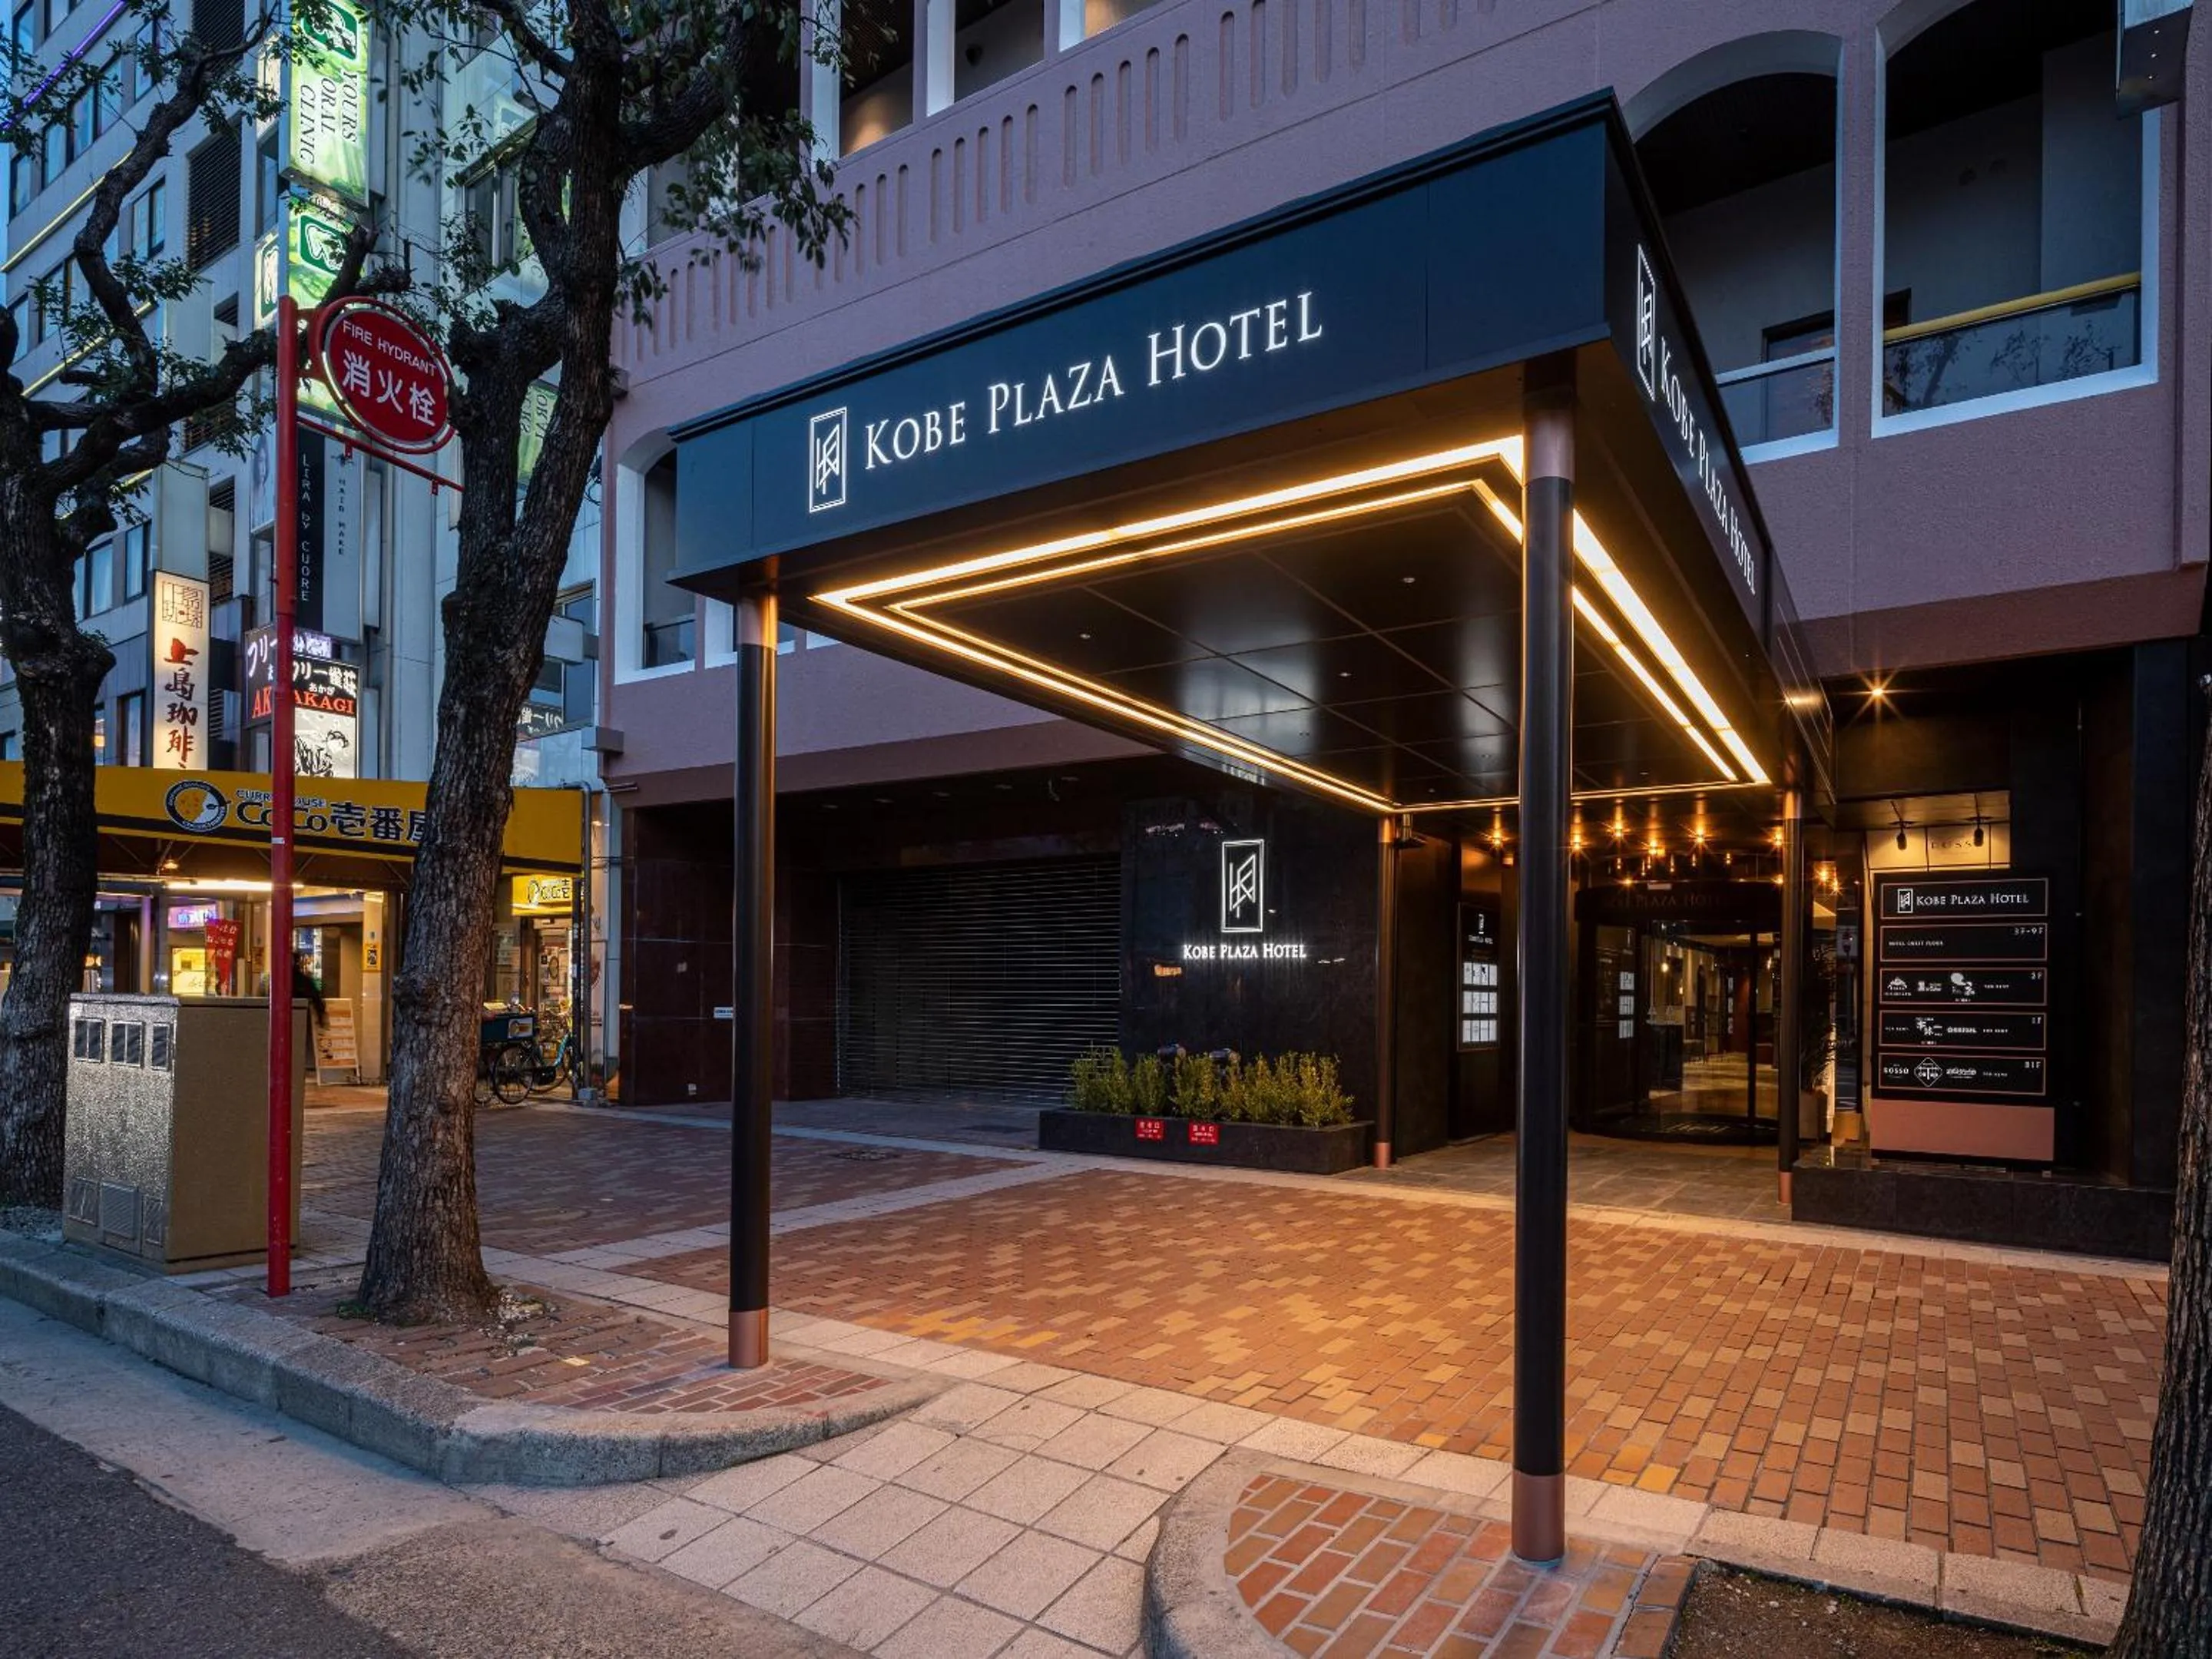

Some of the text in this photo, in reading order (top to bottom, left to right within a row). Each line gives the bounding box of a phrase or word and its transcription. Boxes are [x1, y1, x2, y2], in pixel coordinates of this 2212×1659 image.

[300, 84, 316, 164] CLINIC
[320, 78, 337, 134] ORAL
[341, 71, 359, 144] YOURS
[343, 320, 438, 377] FIRE HYDRANT
[865, 291, 1323, 470] KOBE PLAZA HOTEL
[343, 349, 436, 427] 消火栓
[1661, 336, 1757, 596] KOBE PLAZA HOTEL
[1916, 892, 2029, 906] KOBE PLAZA HOTEL
[1183, 943, 1307, 960] KOBE PLAZA HOTEL
